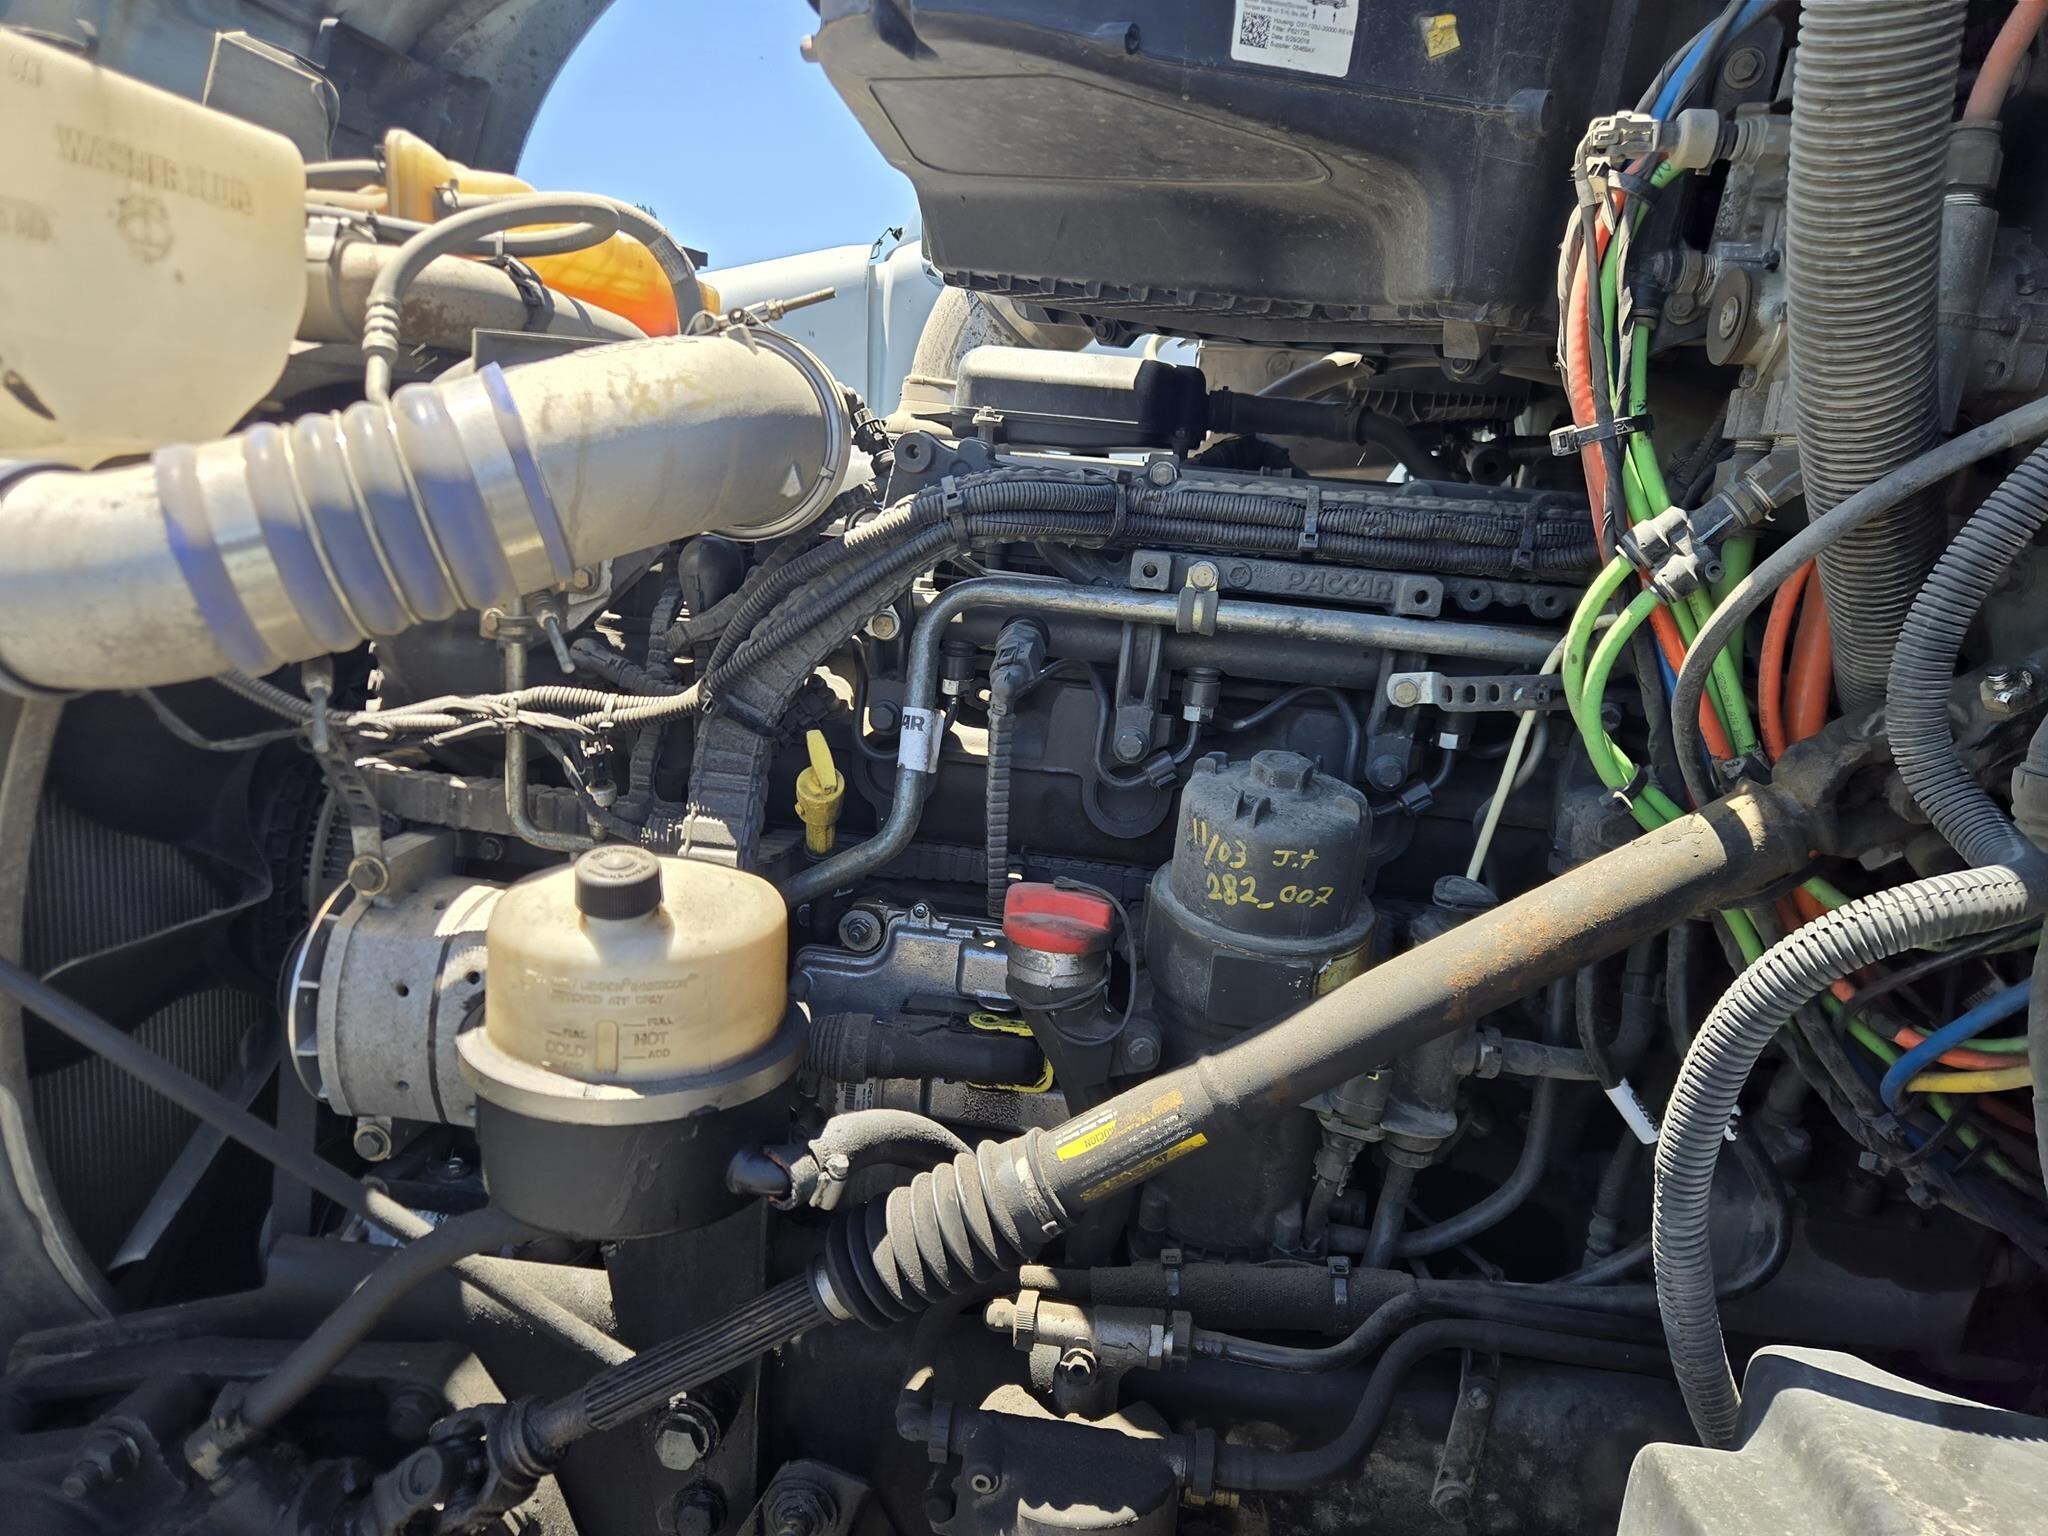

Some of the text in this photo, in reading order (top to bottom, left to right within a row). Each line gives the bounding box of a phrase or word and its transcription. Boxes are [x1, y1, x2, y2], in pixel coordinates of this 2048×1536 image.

[1287, 570, 1395, 600] PACCAR
[1191, 816, 1248, 869] 11/03
[545, 1039, 586, 1058] COLD
[633, 1030, 669, 1047] HOT
